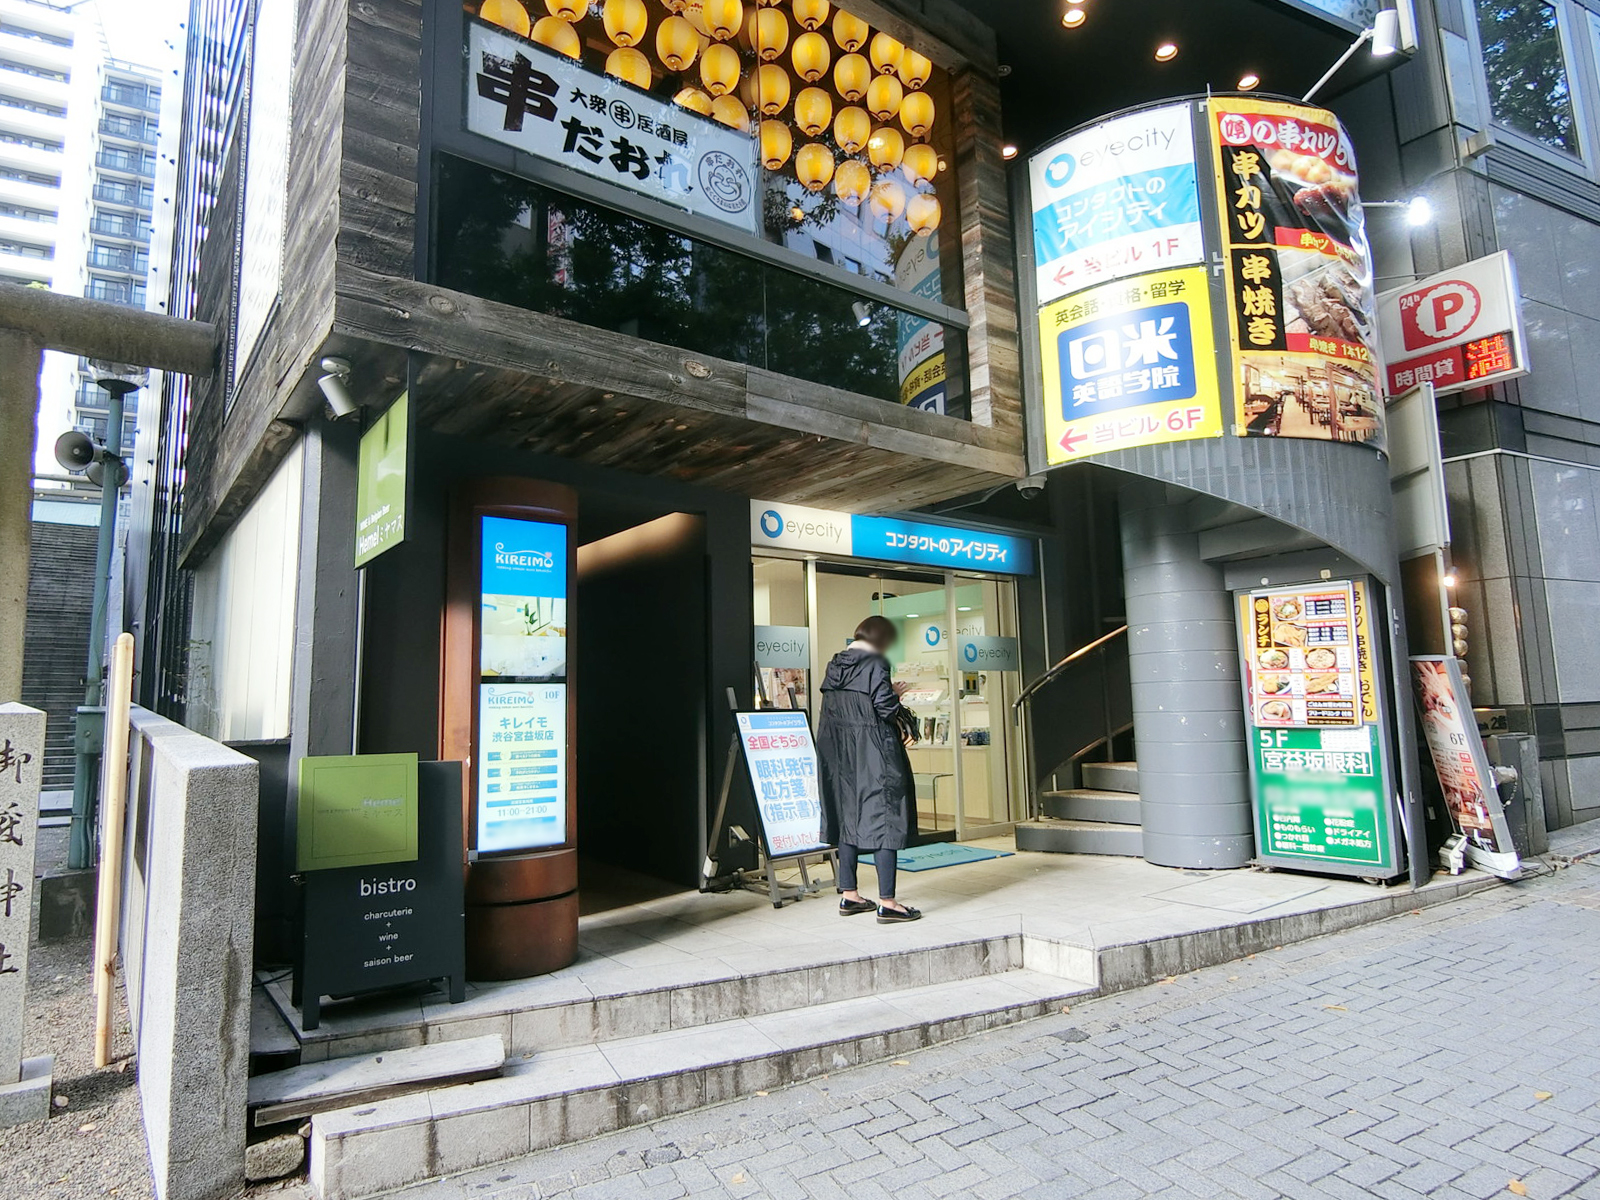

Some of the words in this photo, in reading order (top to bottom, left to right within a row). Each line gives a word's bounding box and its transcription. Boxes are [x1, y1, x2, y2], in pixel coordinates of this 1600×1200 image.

[1079, 126, 1176, 168] eyecity
[1056, 176, 1166, 224] コンタクトの
[1232, 150, 1266, 240] 串カツ
[1058, 201, 1168, 250] アイシティ
[1152, 238, 1180, 258] 1F
[1241, 253, 1278, 346] 串焼き
[1400, 294, 1421, 311] 24h
[1432, 292, 1464, 332] P
[1068, 316, 1178, 380] 日米
[1394, 357, 1455, 388] 時間貸
[1072, 364, 1181, 407] 英語学院
[1095, 415, 1160, 444] 当ビル
[1166, 408, 1202, 431] 6F
[786, 519, 842, 543] eyecity
[885, 531, 1008, 563] コンタクトのアイシティ
[495, 553, 554, 568] KIREIMO
[1256, 613, 1271, 647] ランチ
[757, 639, 805, 658] eyecity
[978, 646, 1012, 661] eyecity
[488, 696, 535, 705] KIREIMO
[545, 690, 560, 699] 10F
[499, 717, 548, 729] キレイモ
[492, 730, 555, 743] 渋谷宮益坂店
[747, 734, 808, 750] 全国どちらの
[1260, 729, 1289, 748] 5F
[1449, 732, 1465, 746] 6F
[1263, 750, 1369, 774] 宮益坂眼科
[1332, 828, 1371, 838] ドライアイ
[360, 877, 417, 897] bistro
[364, 906, 413, 920] charcuterie
[379, 932, 399, 942] wine
[363, 957, 392, 968] saison
[394, 953, 414, 963] beer
